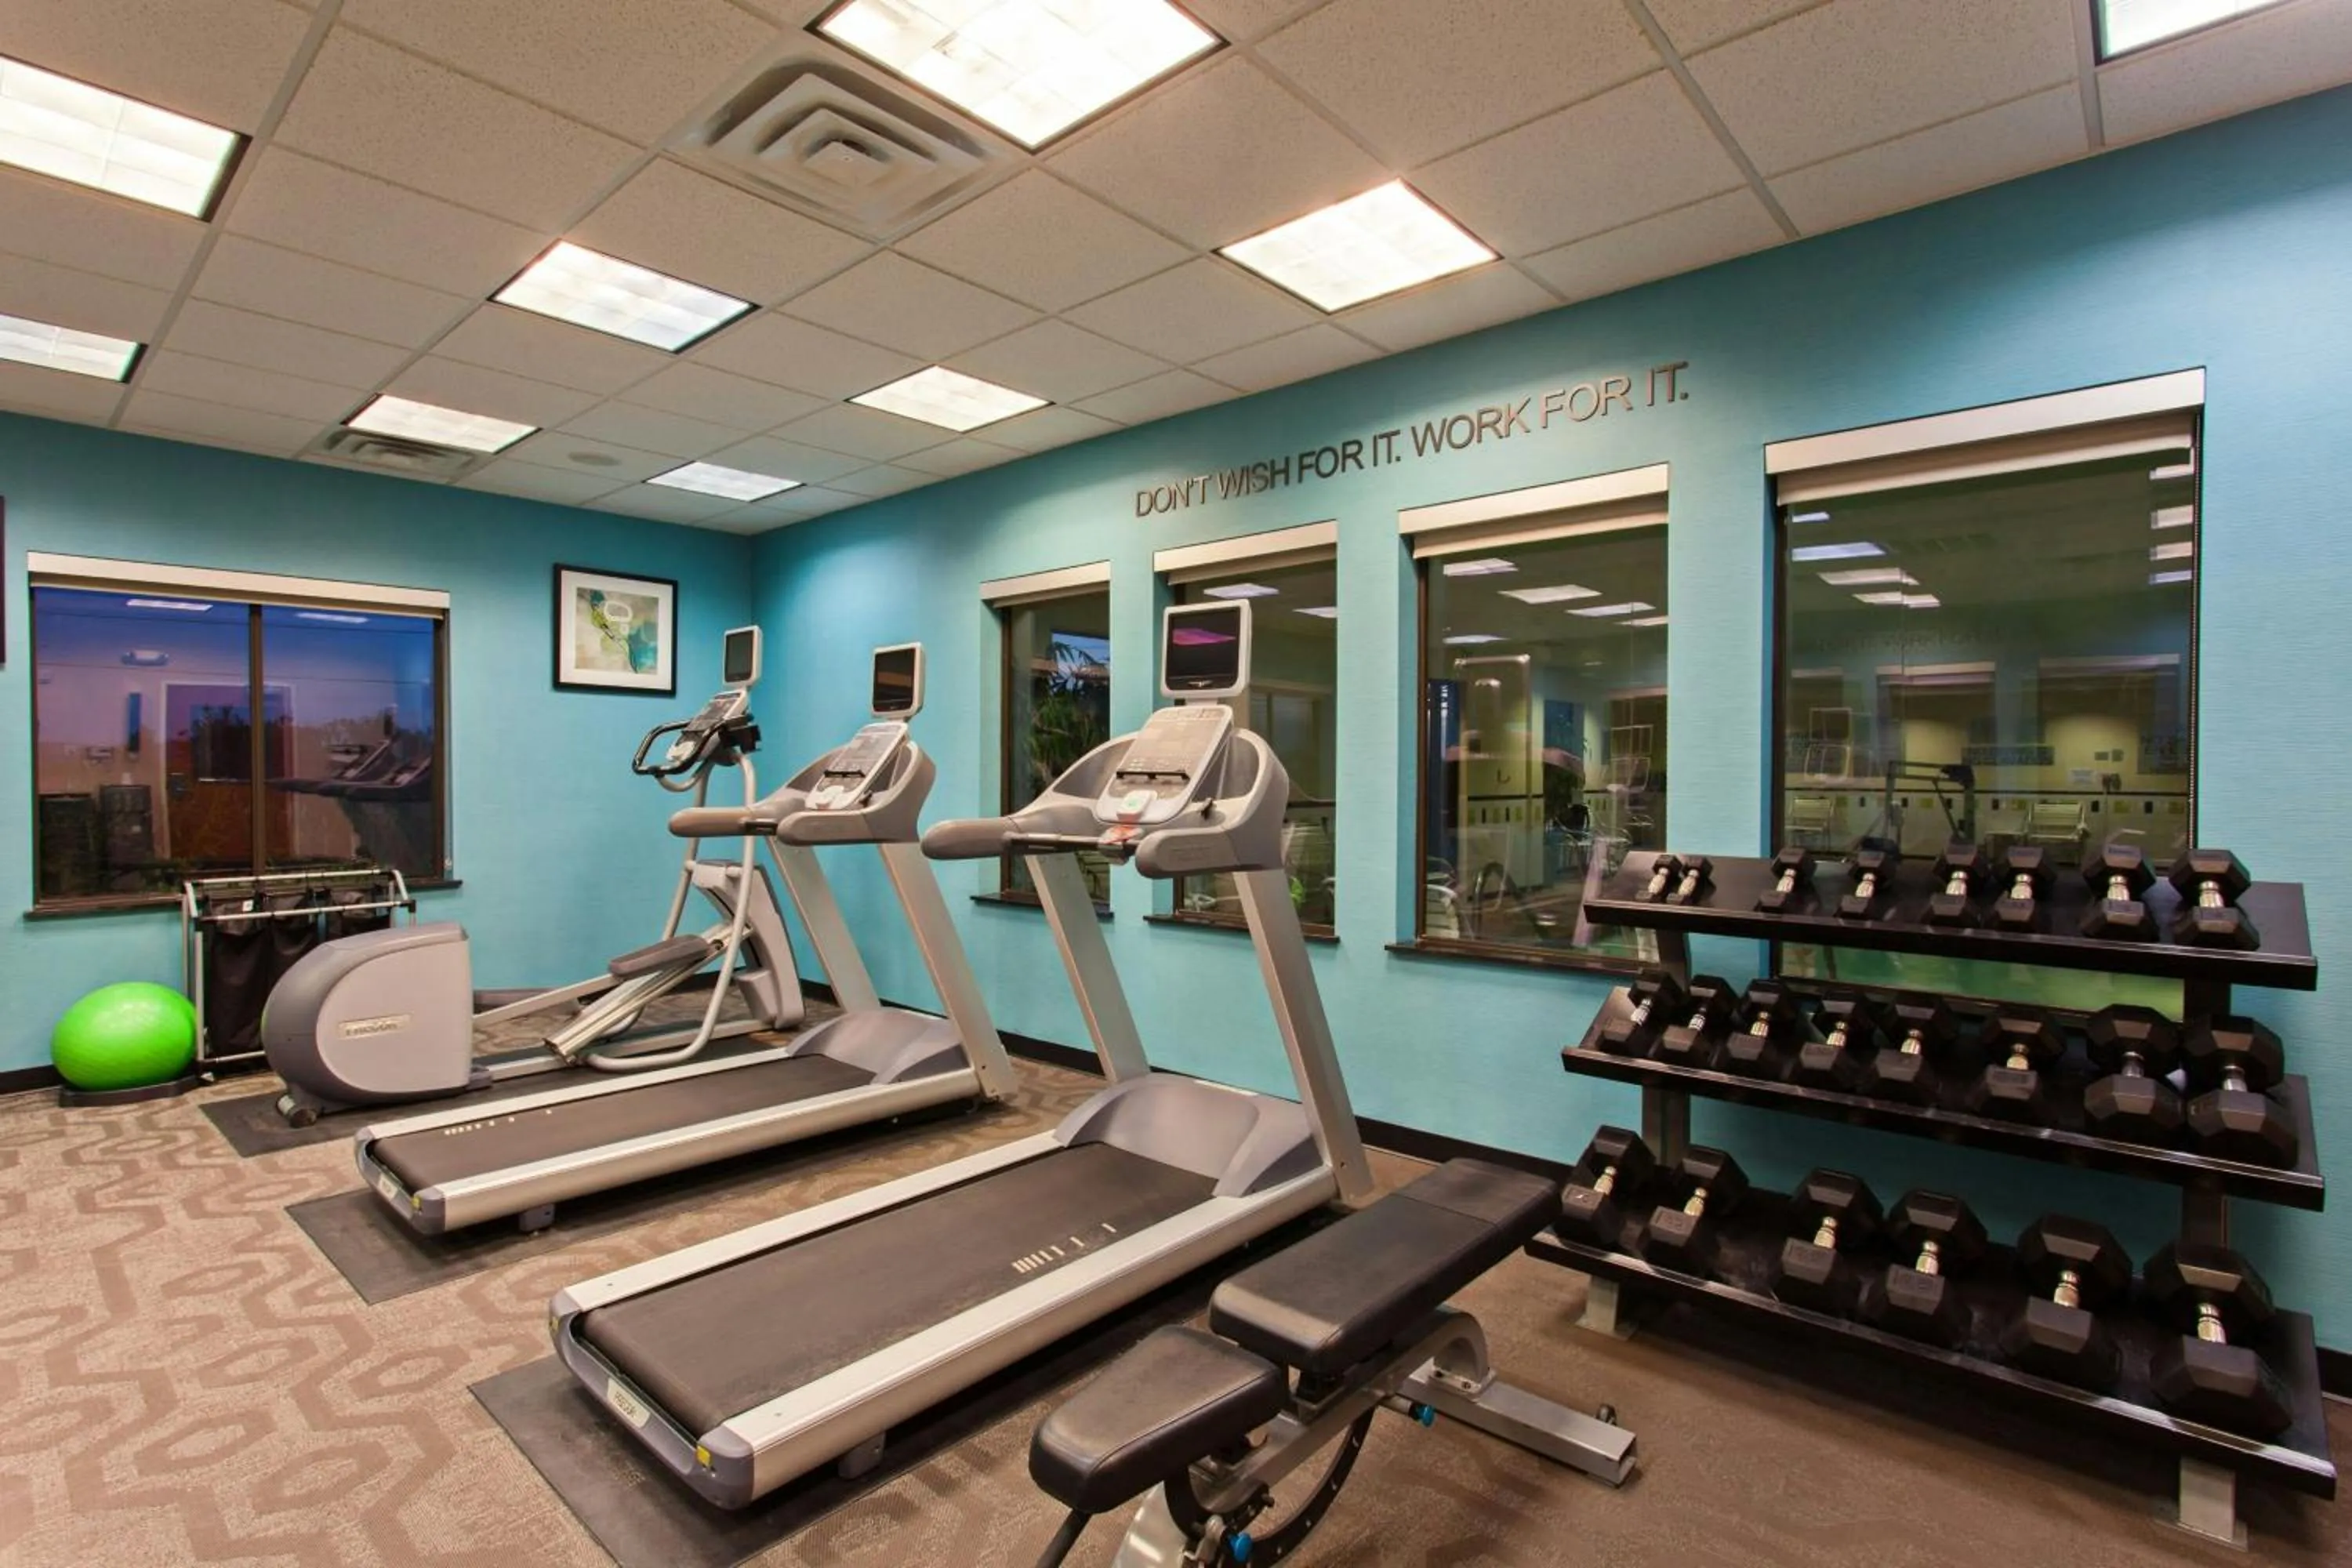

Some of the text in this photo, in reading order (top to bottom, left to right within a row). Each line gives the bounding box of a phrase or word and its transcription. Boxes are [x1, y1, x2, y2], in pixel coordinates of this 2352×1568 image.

[1136, 361, 1690, 517] DON'T WISH FOR IT. WORK FOR IT.
